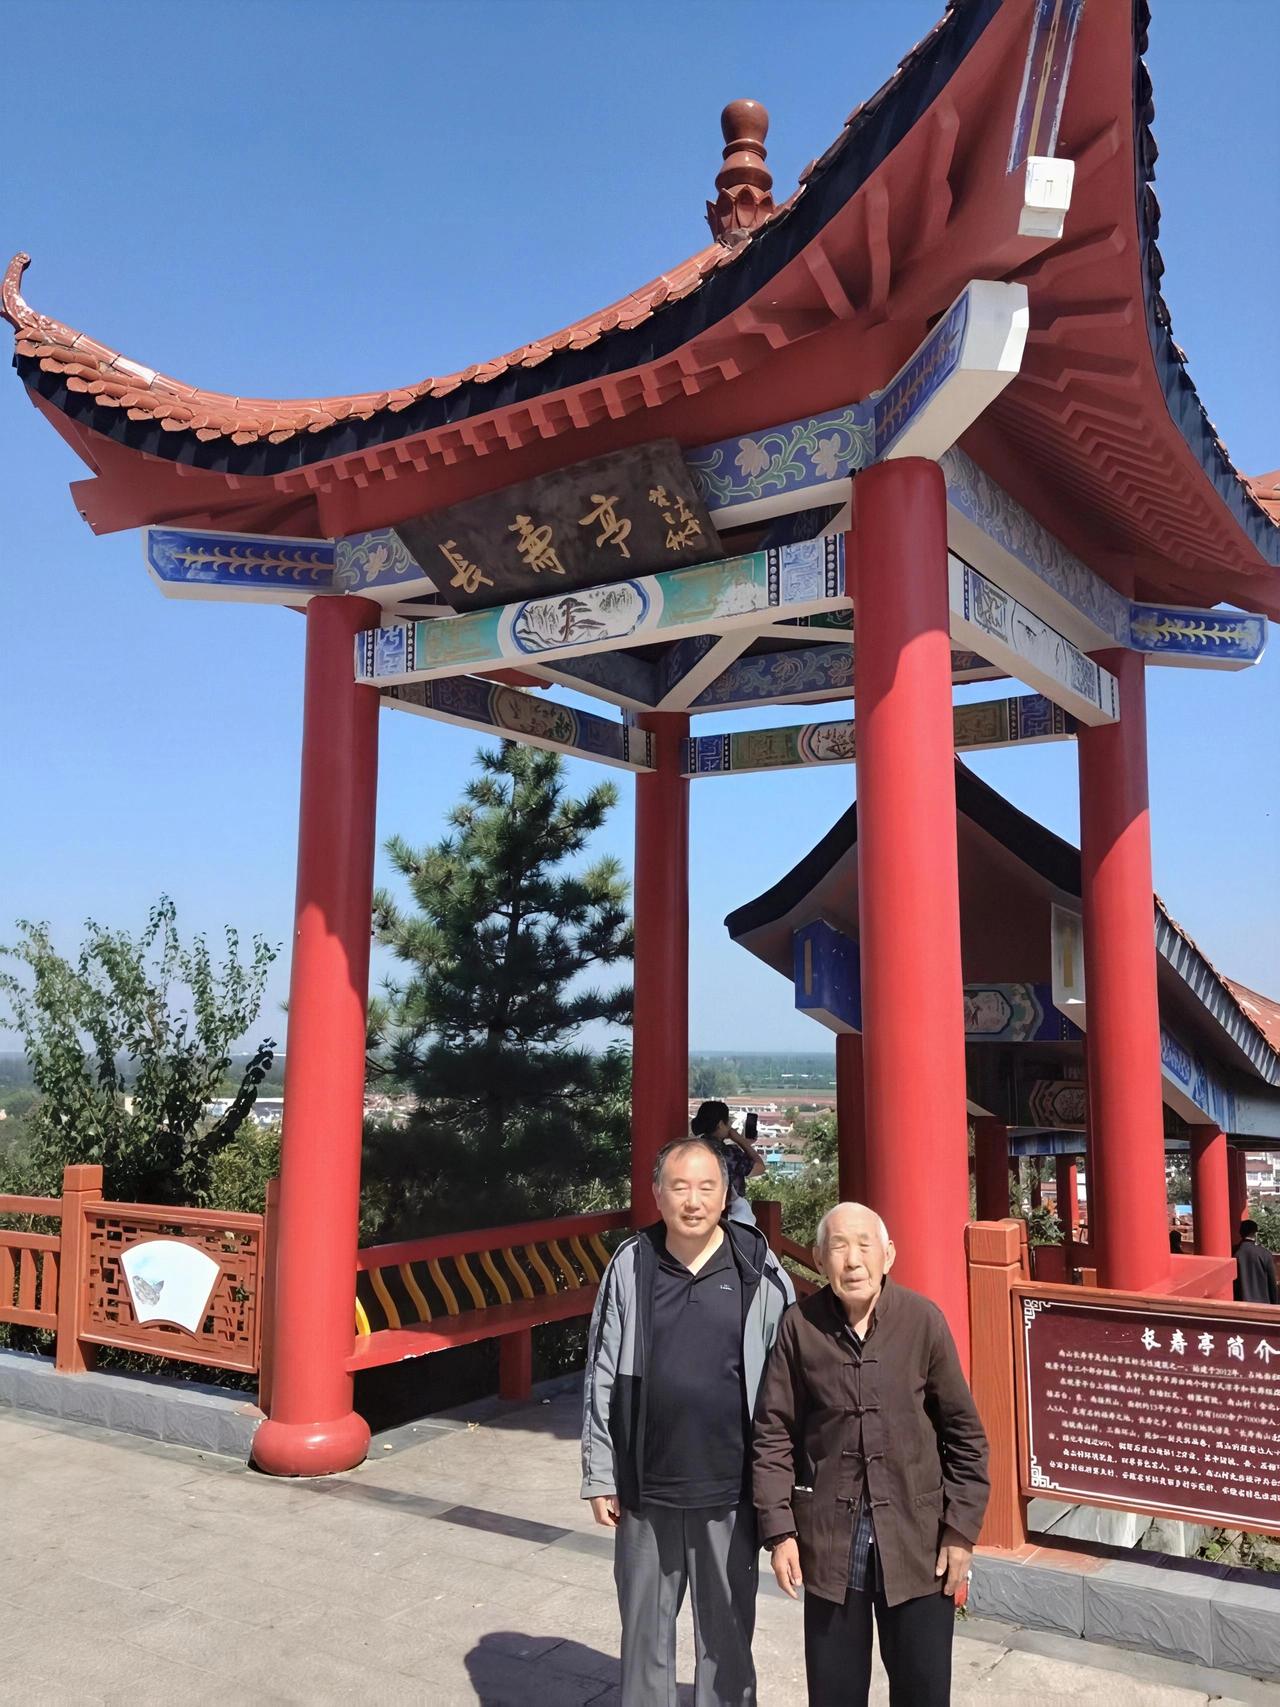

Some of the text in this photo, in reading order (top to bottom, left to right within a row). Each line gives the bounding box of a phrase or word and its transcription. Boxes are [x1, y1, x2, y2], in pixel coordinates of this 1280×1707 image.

[1140, 1326, 1280, 1364] 长寿亭简介
